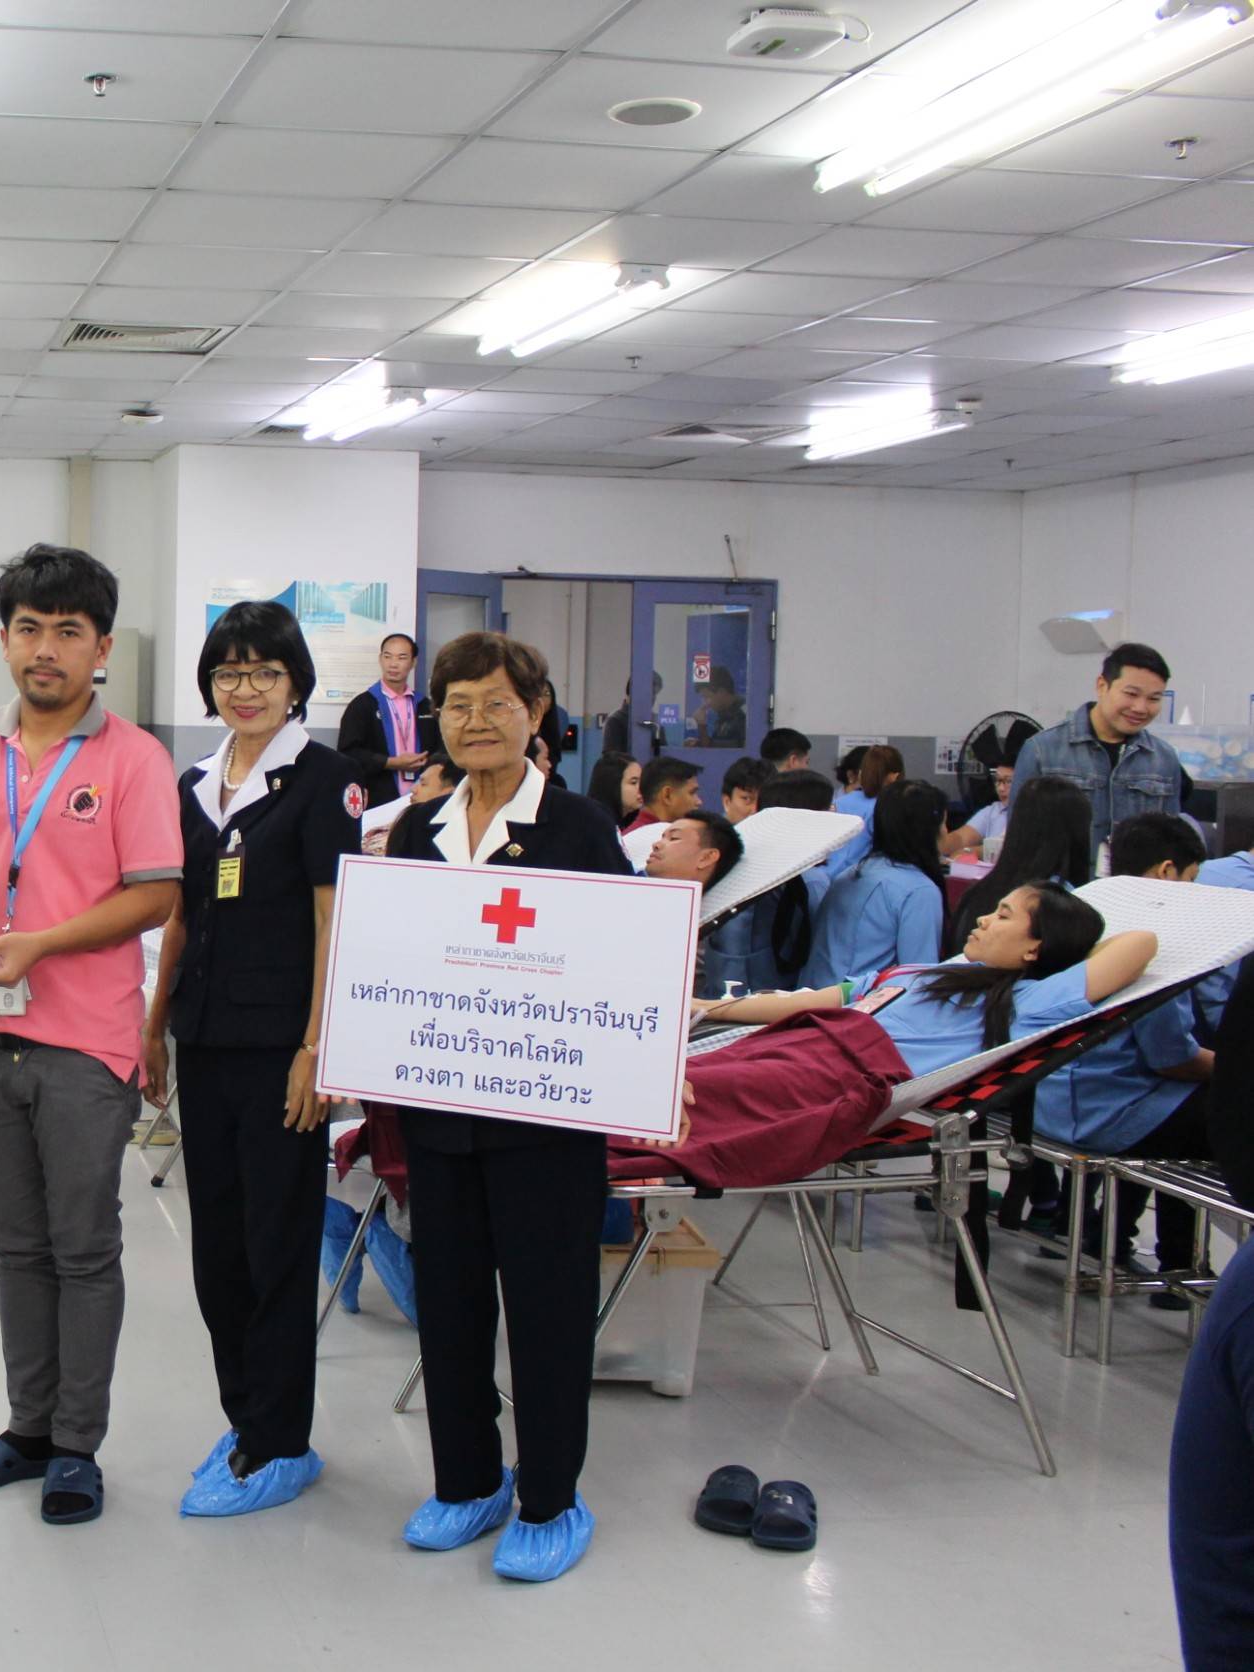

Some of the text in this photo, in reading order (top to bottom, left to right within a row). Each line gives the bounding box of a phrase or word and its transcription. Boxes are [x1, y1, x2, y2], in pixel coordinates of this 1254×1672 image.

[350, 979, 659, 1040] เหล่ากาชาดจังหวัดปราจีนบุรี
[409, 1018, 584, 1067] เพื่อบริจาคโลหิต
[395, 1063, 593, 1105] ดวงตา และอวัยวะ
